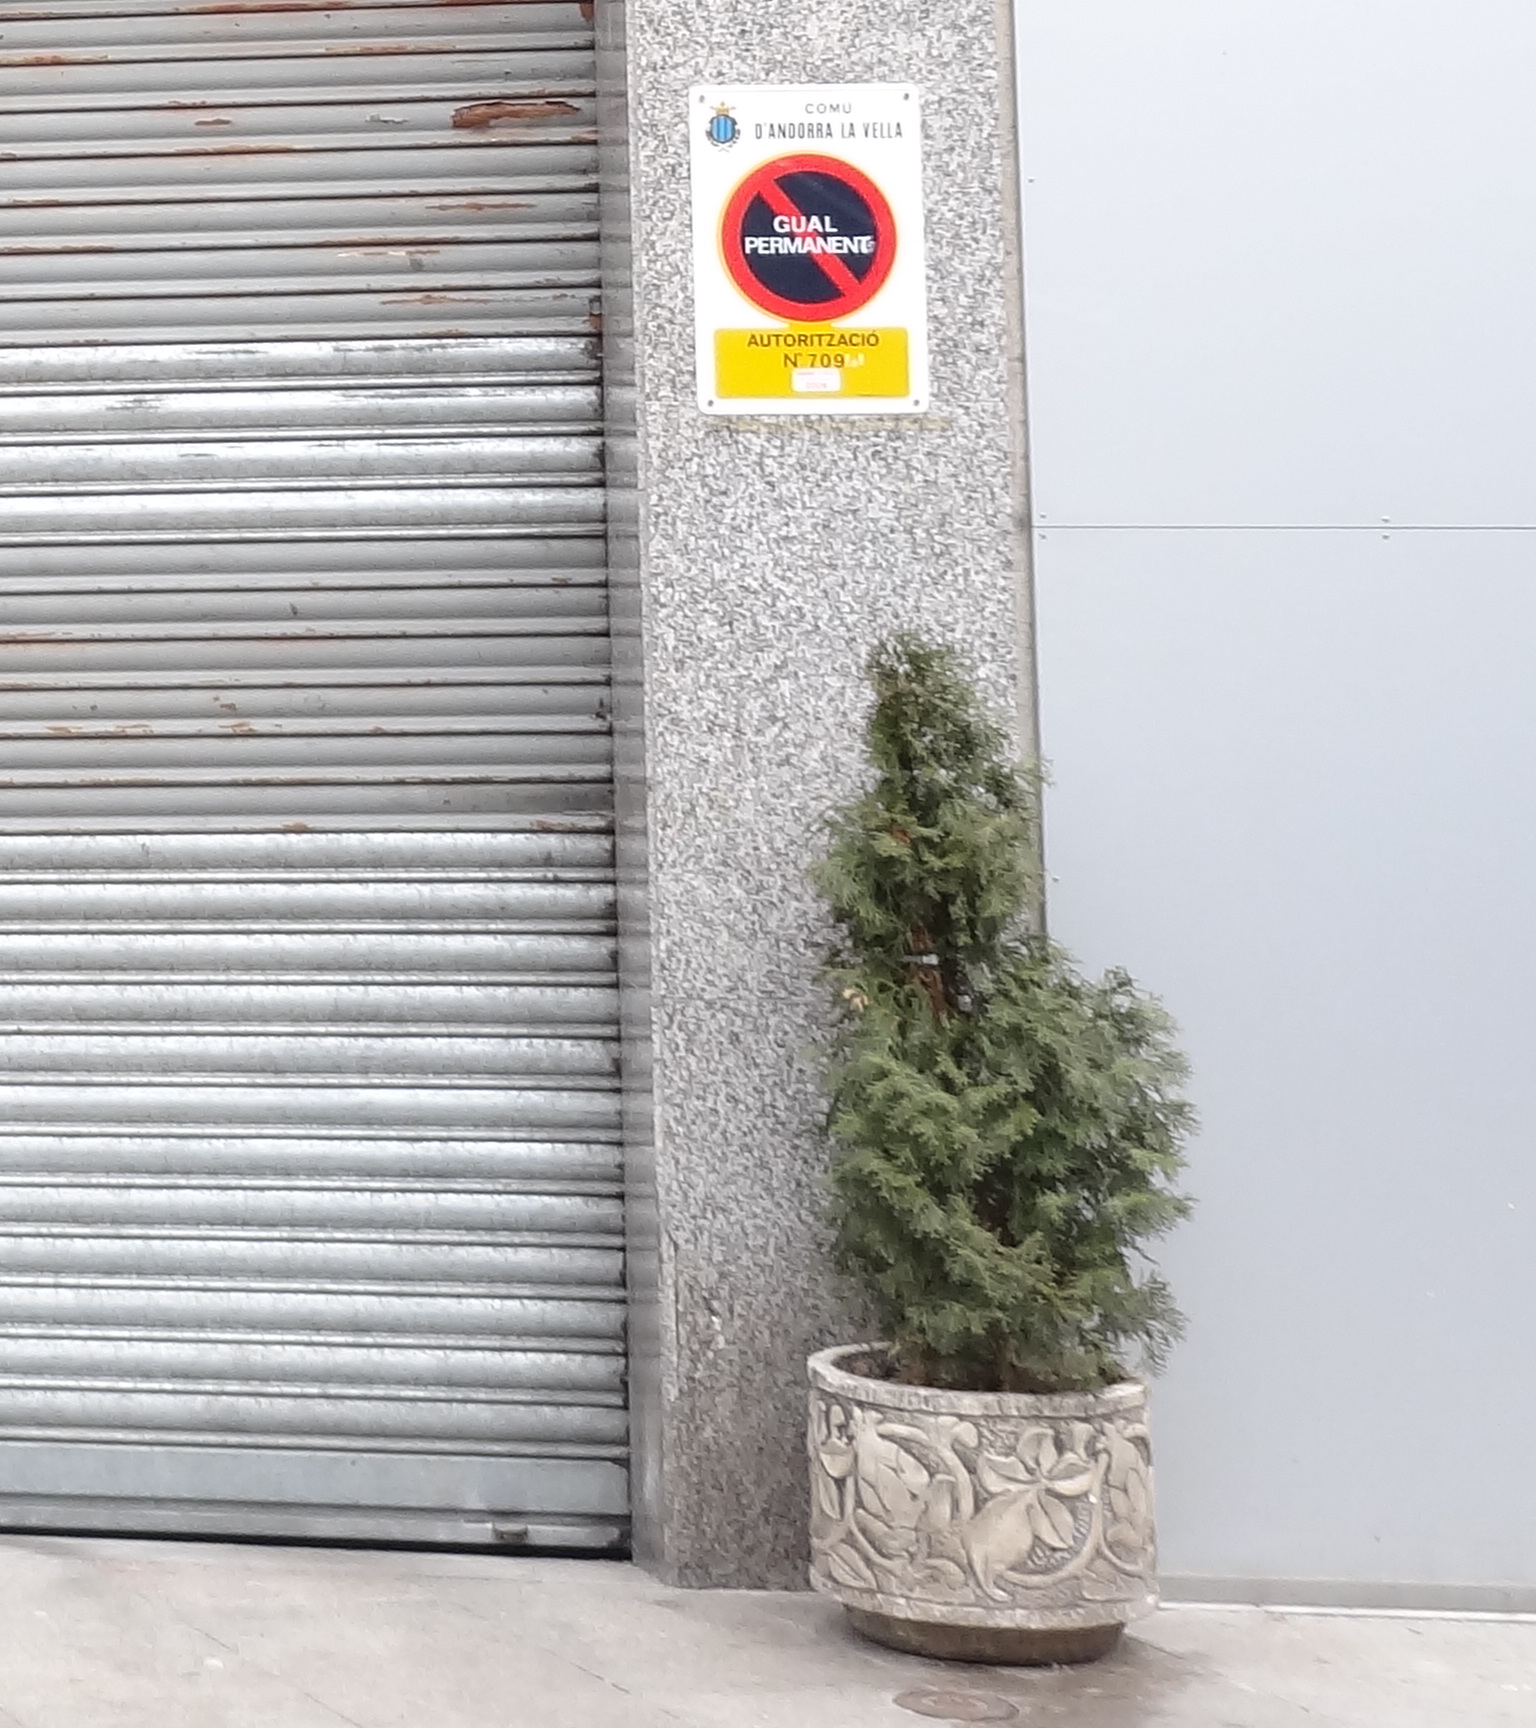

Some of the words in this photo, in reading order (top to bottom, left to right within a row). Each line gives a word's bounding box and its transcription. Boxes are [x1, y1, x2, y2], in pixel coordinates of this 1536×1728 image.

[804, 102, 853, 115] COMÚ
[754, 122, 834, 140] D'ANDORRA
[841, 122, 857, 139] LA
[862, 121, 904, 139] VELLA
[773, 215, 839, 234] GUAL
[747, 331, 880, 348] AUTORITZACIÓ
[808, 353, 845, 368] 709
